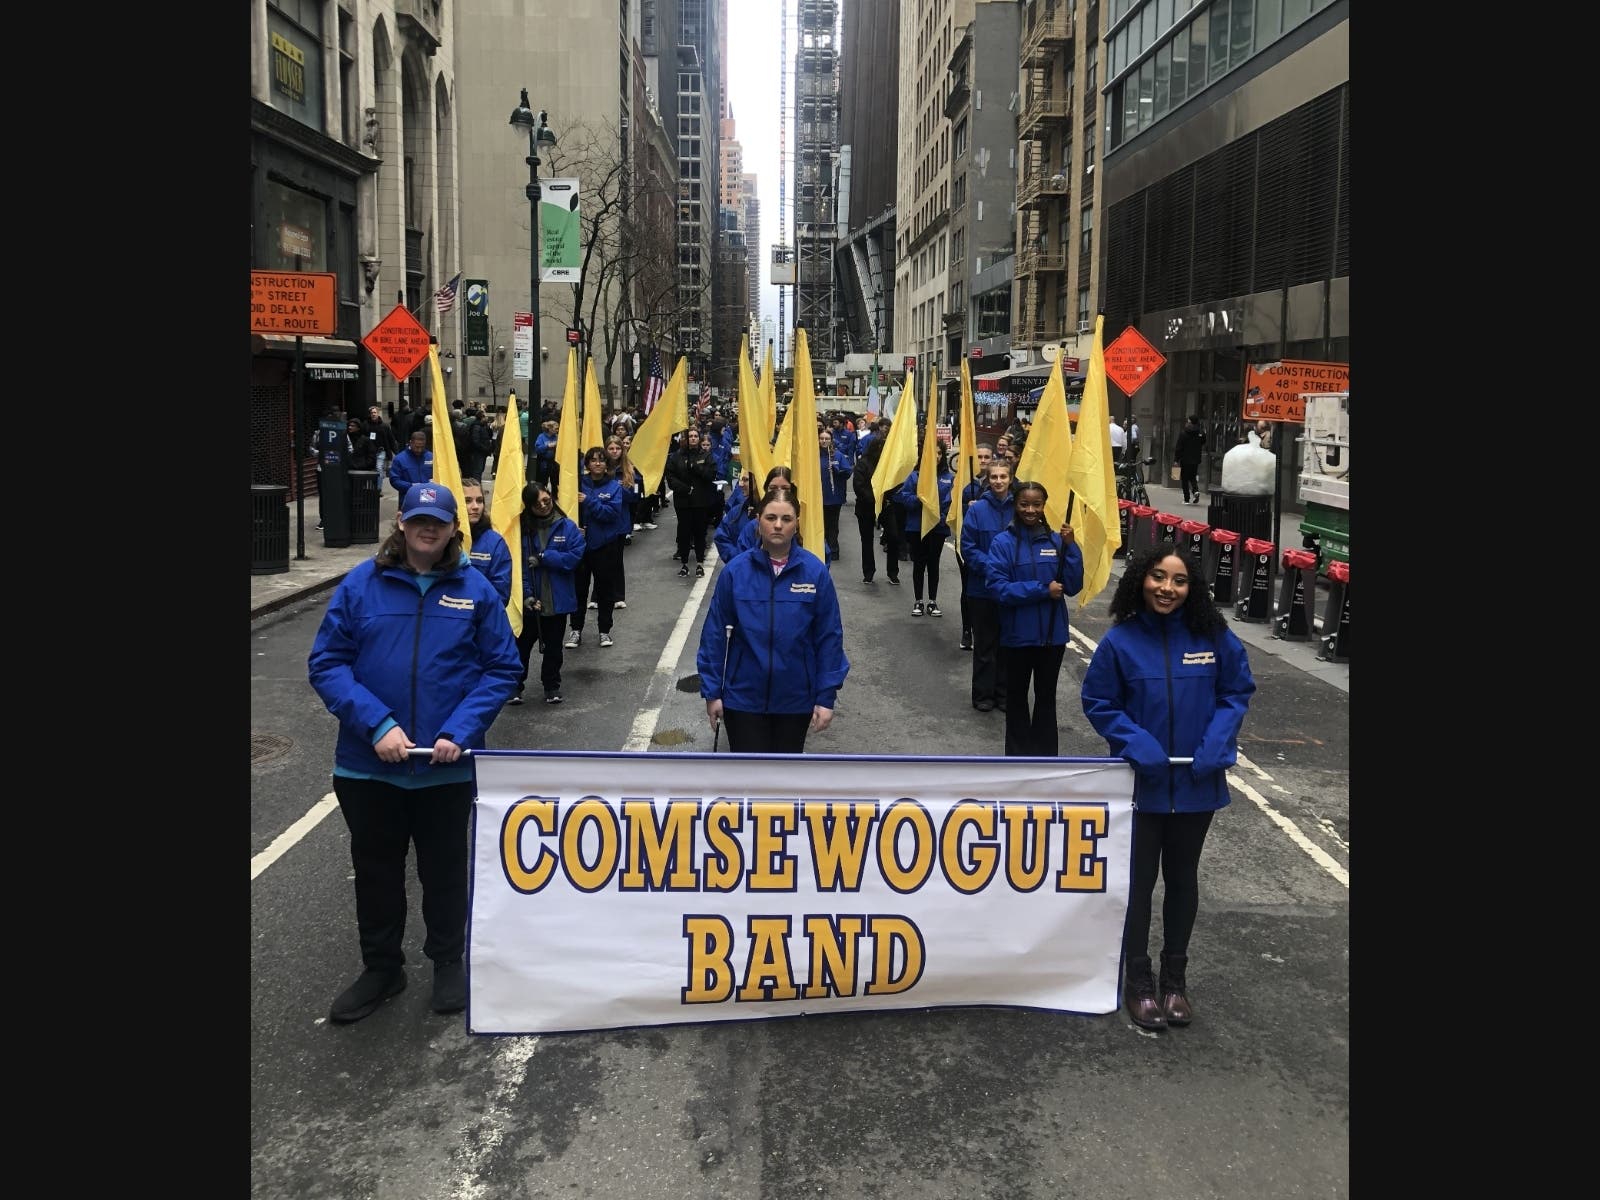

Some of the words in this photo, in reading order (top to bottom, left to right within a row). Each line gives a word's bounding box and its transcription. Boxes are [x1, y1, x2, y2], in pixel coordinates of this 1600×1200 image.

[268, 291, 307, 301] STREET
[270, 304, 314, 316] DELAYS
[254, 318, 280, 328] ALT.
[284, 319, 320, 330] ROUTE
[1270, 366, 1349, 380] CONSTRUCTION
[1303, 381, 1342, 392] STREET
[1268, 392, 1298, 402] AVOID
[1260, 404, 1281, 414] USE
[328, 430, 337, 442] P
[500, 796, 1109, 895] COMSEWOGUE
[681, 914, 926, 1005] BAND
